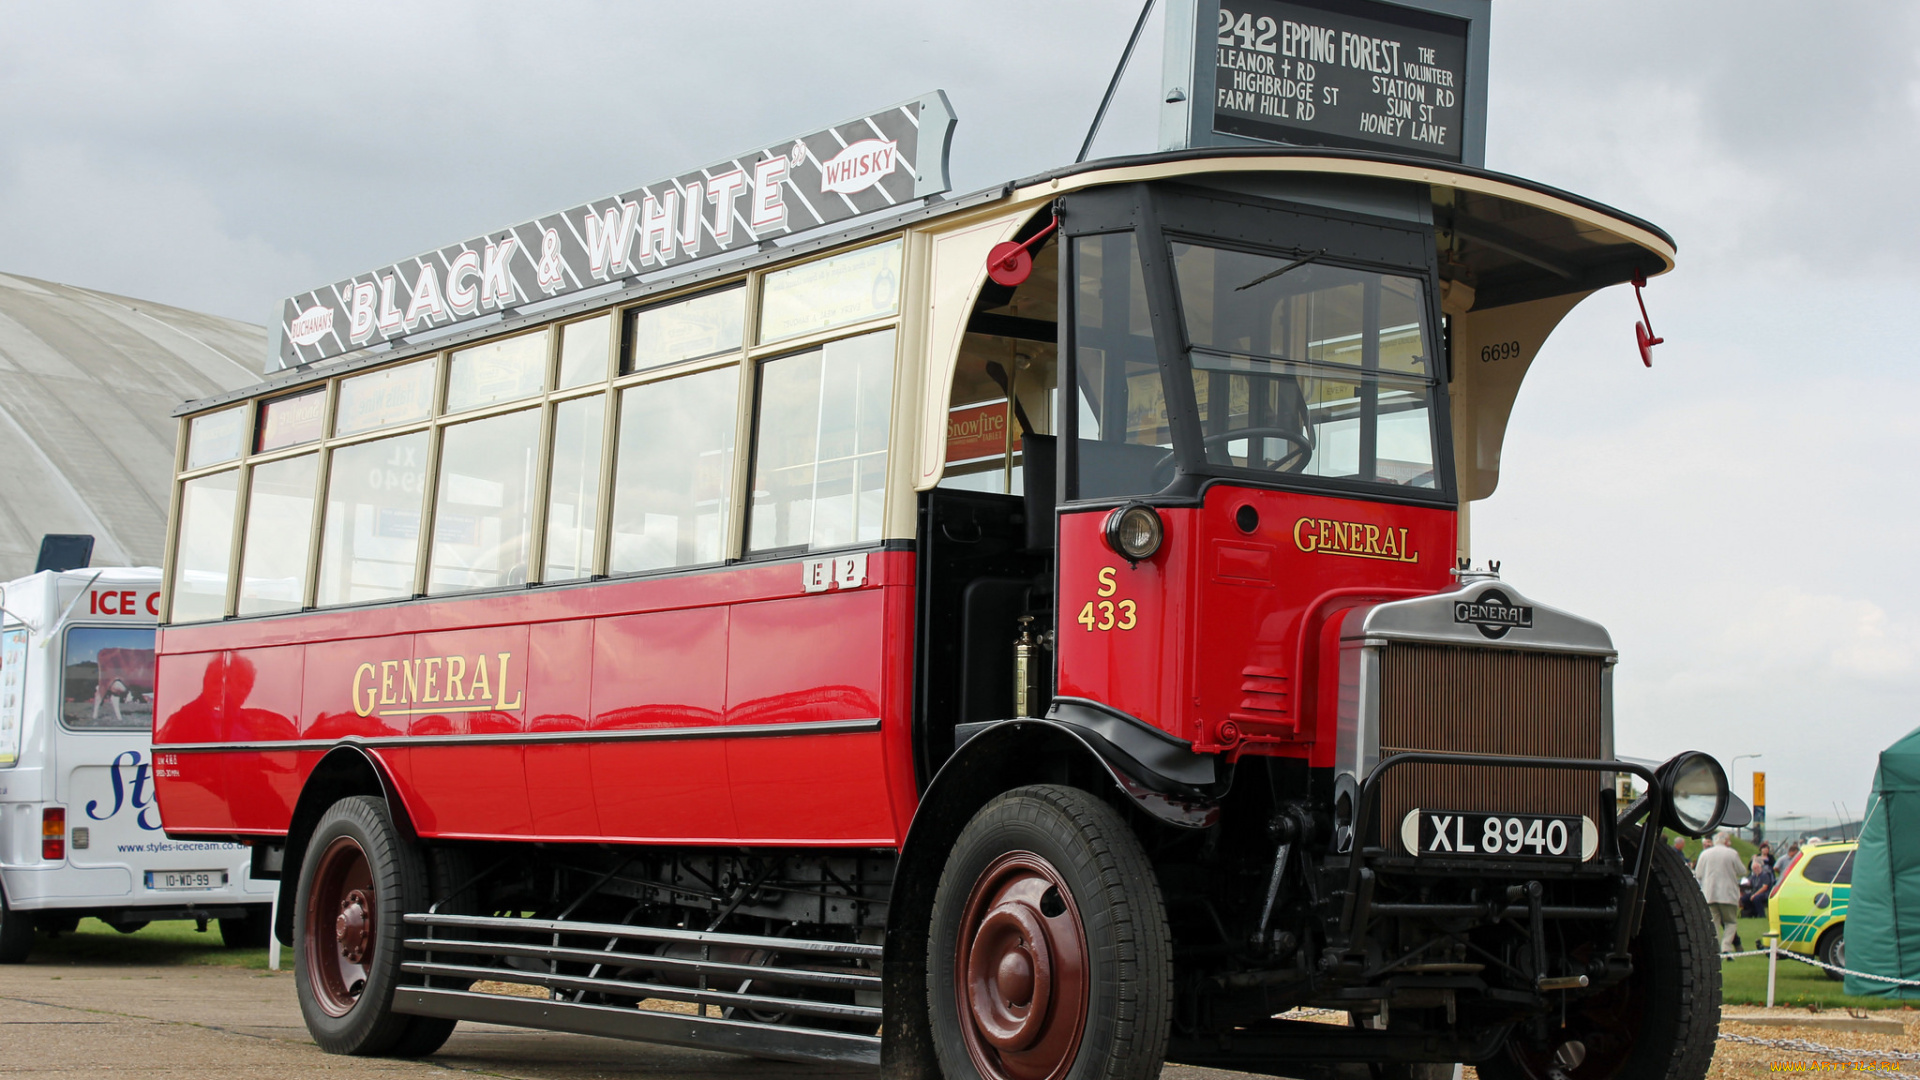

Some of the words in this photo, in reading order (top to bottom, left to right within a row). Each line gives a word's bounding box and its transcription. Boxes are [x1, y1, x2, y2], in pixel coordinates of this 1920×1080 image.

[1218, 9, 1277, 54] 242
[1282, 20, 1336, 64] EPPING
[1341, 31, 1401, 77] FOREST
[1418, 47, 1435, 65] THE
[1297, 61, 1316, 82] RD
[1403, 62, 1454, 87] VOLUNTEER
[1233, 70, 1314, 102] HIGHBRIDGE
[1323, 86, 1339, 106] ST
[1372, 75, 1425, 103] STATION
[1436, 88, 1455, 107] RD
[1217, 88, 1255, 113] FARM
[1260, 95, 1289, 118] HILL
[1296, 101, 1316, 121] RD
[1386, 98, 1412, 119] SUN
[1419, 104, 1434, 123] ST
[1359, 112, 1404, 137] HONEY
[1411, 121, 1447, 145] LANE
[826, 147, 893, 185] WHISKY
[538, 227, 567, 294] &
[292, 312, 333, 339] BUCHANAN'S
[1481, 341, 1520, 362] 6699
[947, 412, 1004, 446] Snowfire
[1293, 516, 1419, 564] GENERAL
[812, 563, 823, 586] E
[846, 559, 855, 582] 2
[1097, 566, 1118, 598] S
[90, 590, 137, 615] ICE
[1077, 599, 1138, 632] 433
[1455, 602, 1532, 626] GENERAL
[352, 652, 522, 718] GENERAL
[1428, 815, 1476, 853] XL
[1482, 816, 1568, 856] 8940
[166, 874, 209, 887] 10-WD-99
